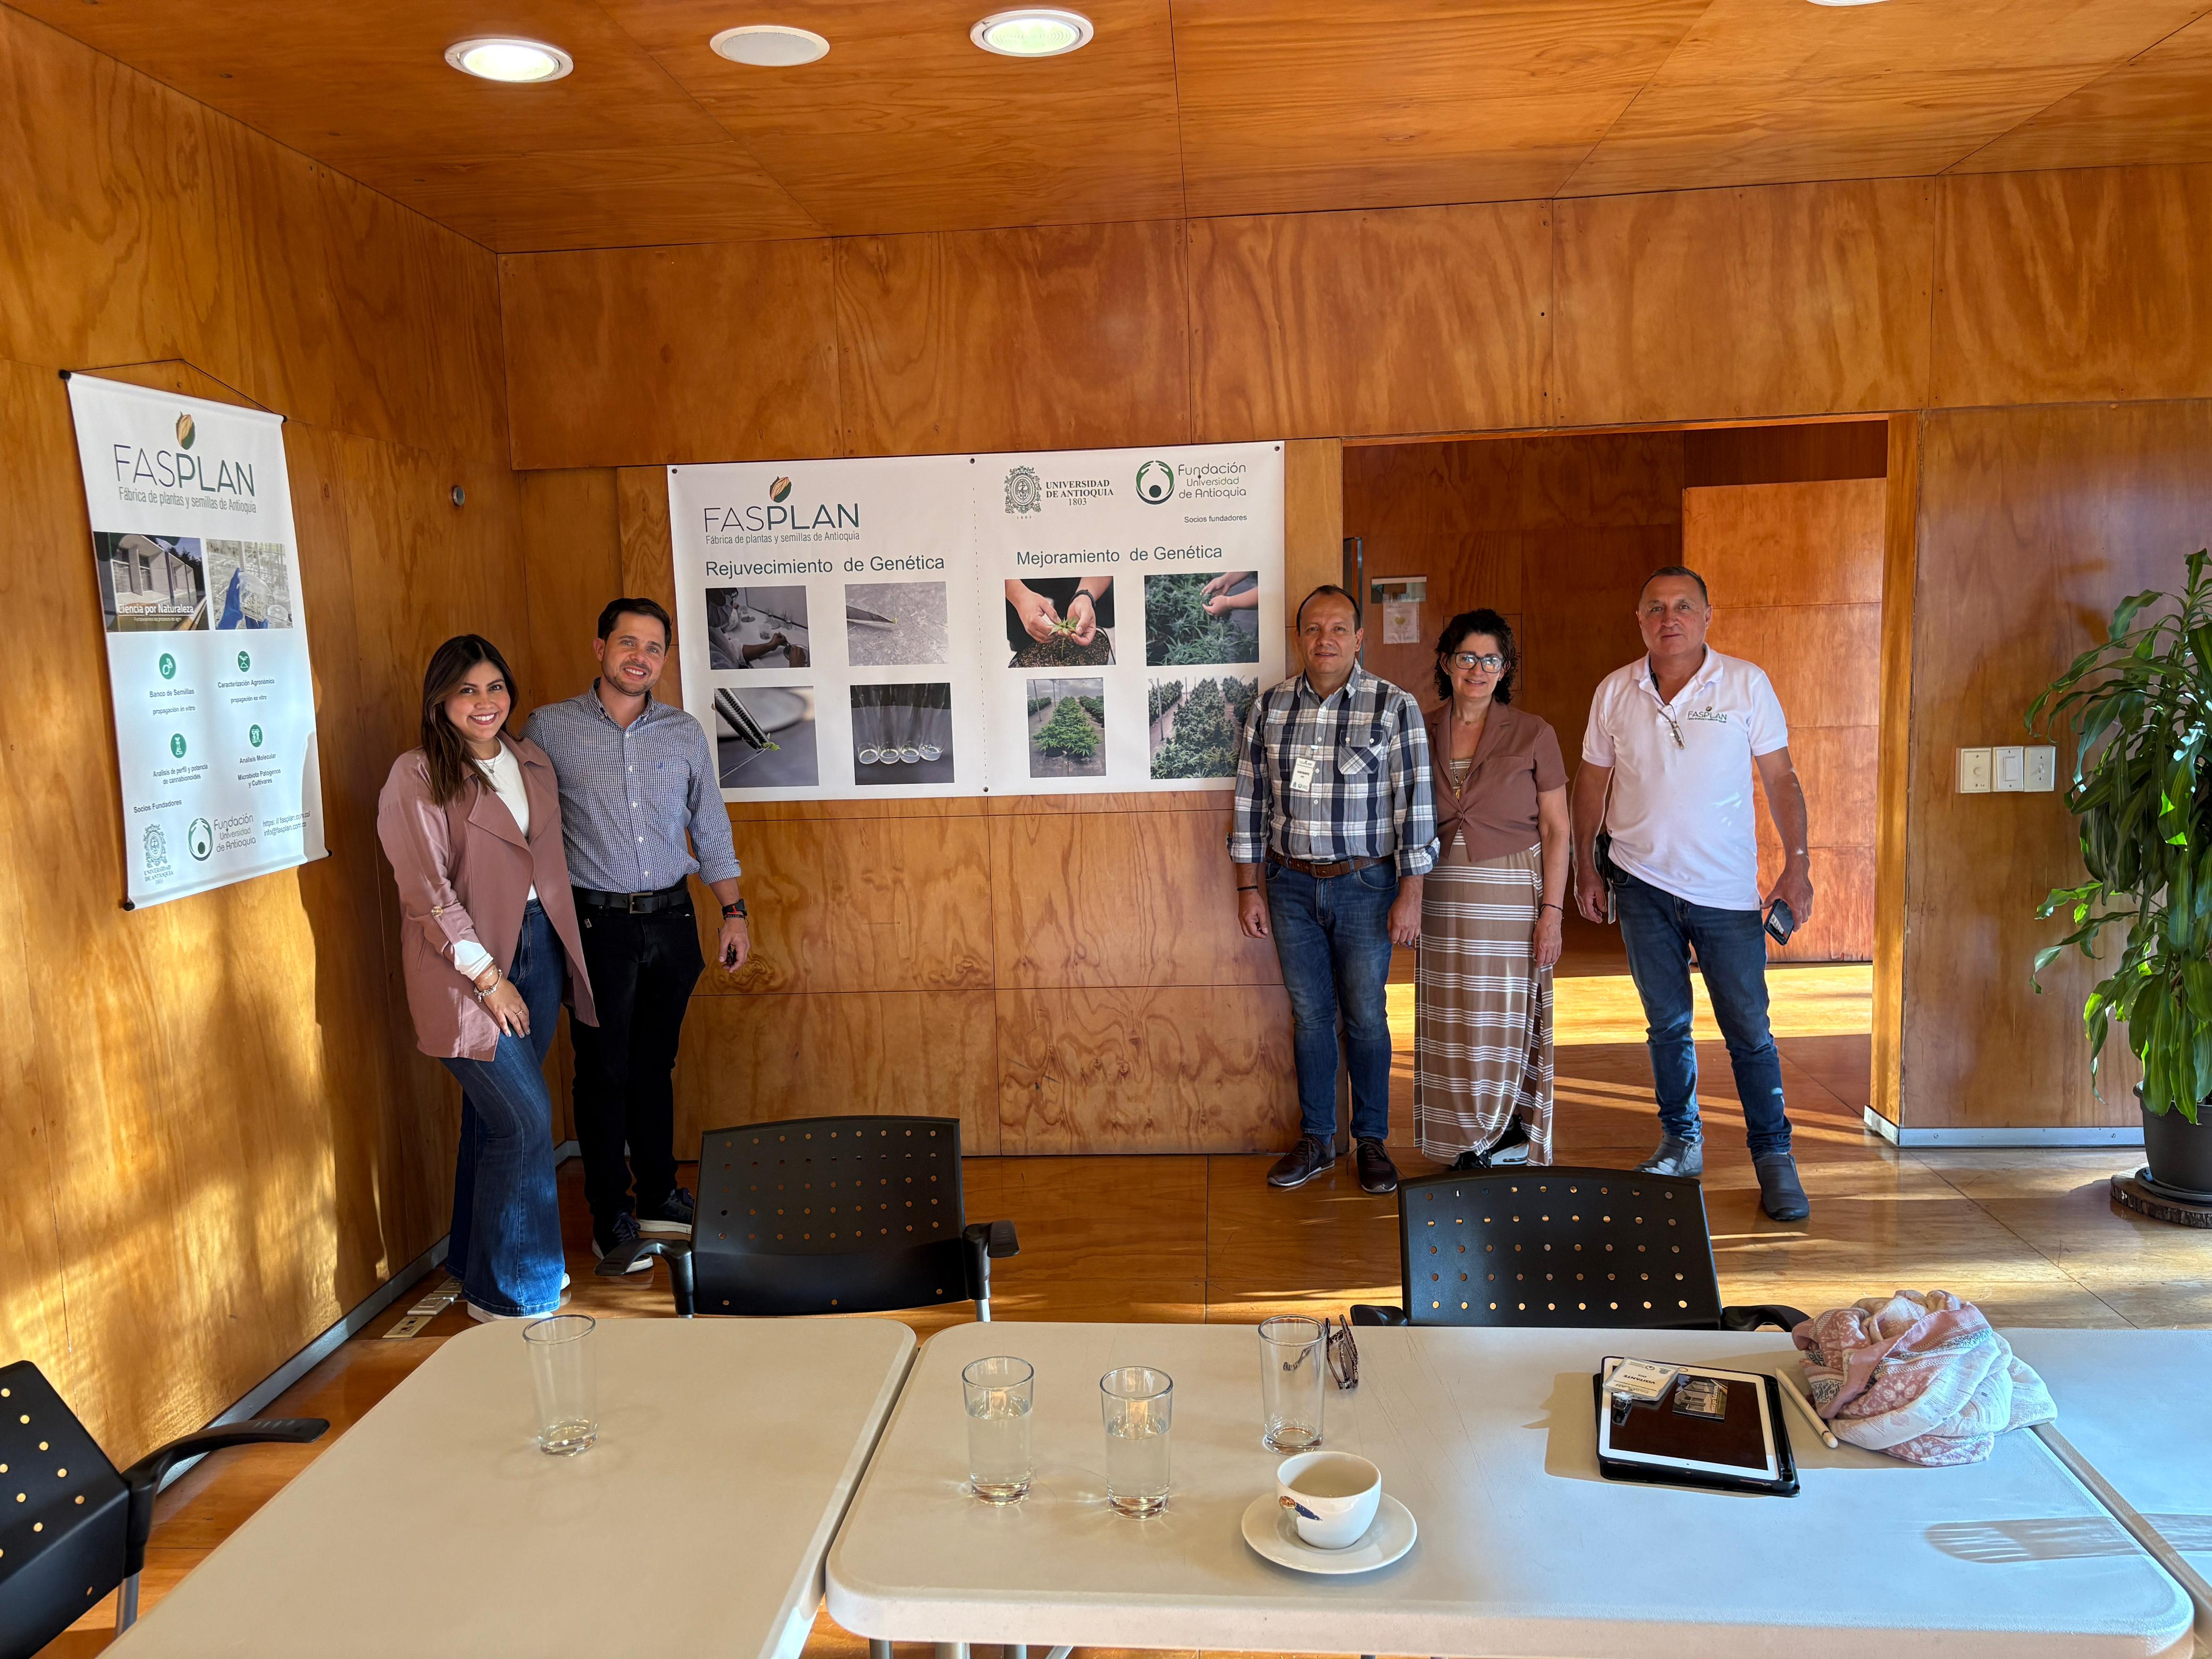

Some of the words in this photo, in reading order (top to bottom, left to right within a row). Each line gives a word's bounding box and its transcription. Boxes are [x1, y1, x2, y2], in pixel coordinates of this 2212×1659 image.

[114, 444, 255, 497] FASPLAN
[1178, 462, 1246, 477] Fundación
[1046, 480, 1110, 489] UNIVERSIDAD
[1187, 476, 1239, 487] Universidad
[1060, 488, 1115, 498] ANTIOQUIA
[1179, 489, 1192, 499] de
[1195, 487, 1247, 499] Antioquia
[119, 486, 147, 502] Fábrica
[149, 490, 158, 504] de
[160, 491, 185, 506] plantas
[186, 497, 190, 509] y
[191, 496, 218, 510] semillas
[220, 497, 228, 510] de
[229, 499, 257, 515] Antioquia
[704, 503, 860, 532] FASPLAN
[1209, 514, 1247, 523] fundadores
[706, 533, 733, 544] Fábrica
[735, 534, 744, 544] de
[746, 533, 773, 545] plantas
[775, 535, 779, 544] y
[781, 532, 811, 542] semillas
[814, 532, 823, 541] de
[824, 531, 860, 542] Antioquia
[1017, 549, 1120, 568] Mejoramiento
[1130, 548, 1149, 561] de
[1154, 544, 1222, 560] Genética
[706, 558, 833, 579] Rejuvecimiento
[844, 557, 864, 572] de
[870, 555, 945, 571] Genética
[118, 604, 144, 614] Ciencia
[145, 605, 157, 615] por
[158, 604, 195, 614] Naturaleza
[217, 680, 250, 688] Caracterización
[153, 707, 180, 716] propagación
[1688, 711, 1727, 720] FASPLAN
[191, 763, 208, 773] potencia
[238, 772, 259, 781] Microbiota
[259, 768, 281, 777] Patógenos
[152, 800, 182, 810] Fundadores
[214, 812, 254, 831] Fundación
[220, 826, 251, 840] Universidad
[216, 843, 225, 852] de
[226, 835, 256, 850] Antioquia
[1623, 1374, 1655, 1385] VISITANTE
